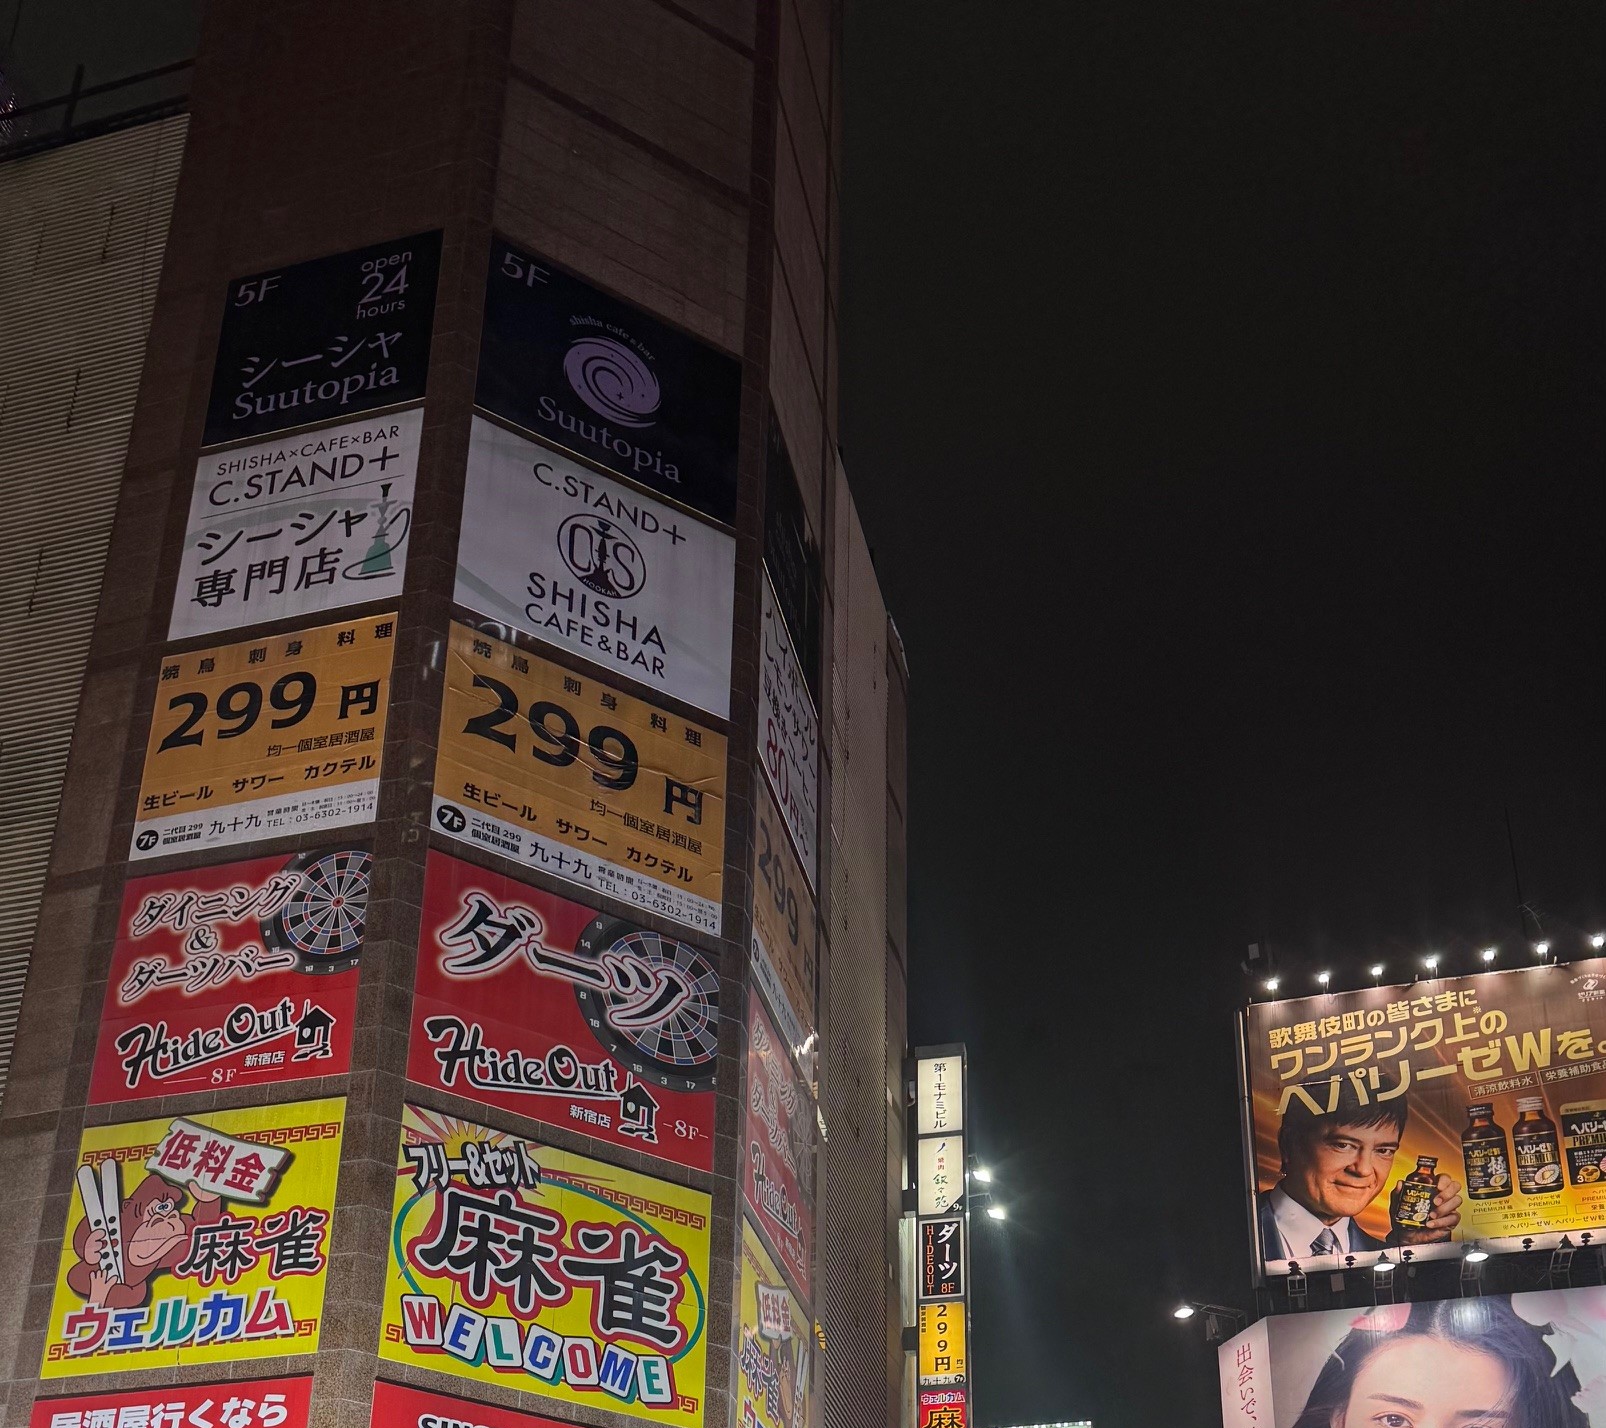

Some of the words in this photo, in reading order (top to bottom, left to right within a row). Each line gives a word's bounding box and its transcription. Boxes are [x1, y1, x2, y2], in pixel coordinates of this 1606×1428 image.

[236, 275, 283, 307] 5F
[359, 270, 410, 304] 24
[361, 248, 412, 275] open
[500, 252, 552, 288] 5F
[355, 298, 406, 321] hours
[240, 328, 403, 388] シーシャ
[232, 362, 401, 421] Suutopia
[537, 396, 682, 484] Suutopia
[208, 445, 400, 507] C.STAND+
[533, 462, 687, 547] C.STAND+
[197, 508, 368, 567] シーシャ
[191, 546, 345, 608] 専門店
[524, 602, 666, 680] CAFE&BAR
[526, 572, 668, 656] SHISHA
[142, 785, 215, 812] 生ビール
[232, 774, 284, 794] サワー
[304, 754, 376, 781] カクテル
[208, 813, 262, 837] 九十九
[462, 782, 538, 824] 生ビール
[555, 818, 608, 847] サワー
[626, 846, 694, 885] カクテル
[589, 798, 703, 857] 均一個室居酒屋
[530, 840, 593, 881] 九十九
[133, 873, 303, 938] ダイニング
[185, 923, 218, 956] &
[441, 892, 691, 1027] ダーツ
[121, 945, 296, 1004] ダーツバー
[1268, 988, 1478, 1050] 歌舞伎町の皆さまに
[210, 1068, 237, 1085] 8F
[244, 1051, 285, 1068] 新宿店
[1473, 1076, 1534, 1096] 清涼飲料水
[569, 1104, 611, 1129] 新宿店
[157, 1128, 267, 1195] 低料金
[173, 1208, 327, 1284] 麻雀
[412, 1187, 684, 1353] 麻雀
[926, 1225, 935, 1296] HIDEOUT
[937, 1222, 959, 1280] ダーツ
[941, 1282, 955, 1294] 8F
[62, 1286, 295, 1355] ウェルカム
[402, 1296, 670, 1399] WELCOME
[740, 1323, 780, 1428] 麻雀
[920, 1391, 966, 1406] ウェルカム
[922, 1375, 951, 1385] 九十九
